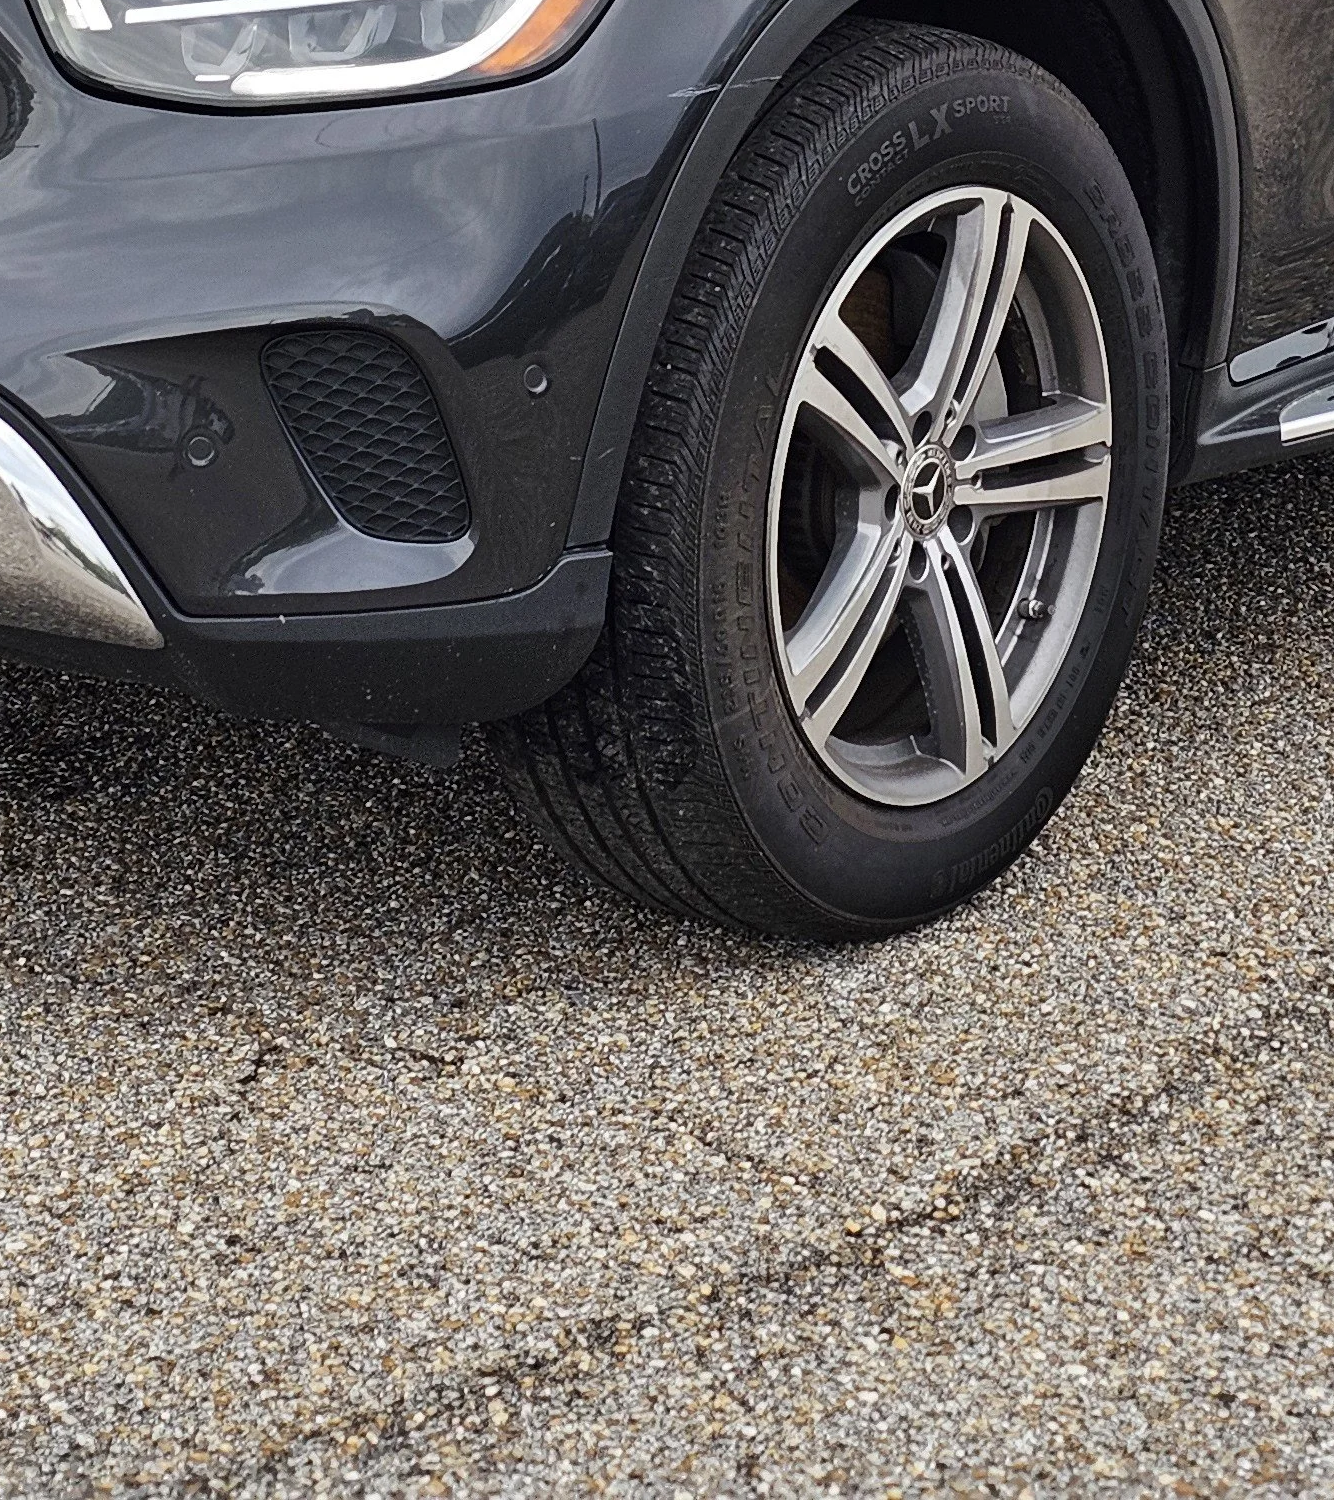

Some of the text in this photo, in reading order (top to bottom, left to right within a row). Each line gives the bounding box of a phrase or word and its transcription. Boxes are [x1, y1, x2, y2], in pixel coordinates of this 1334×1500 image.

[847, 95, 1011, 195] CROSS LX SPORT
